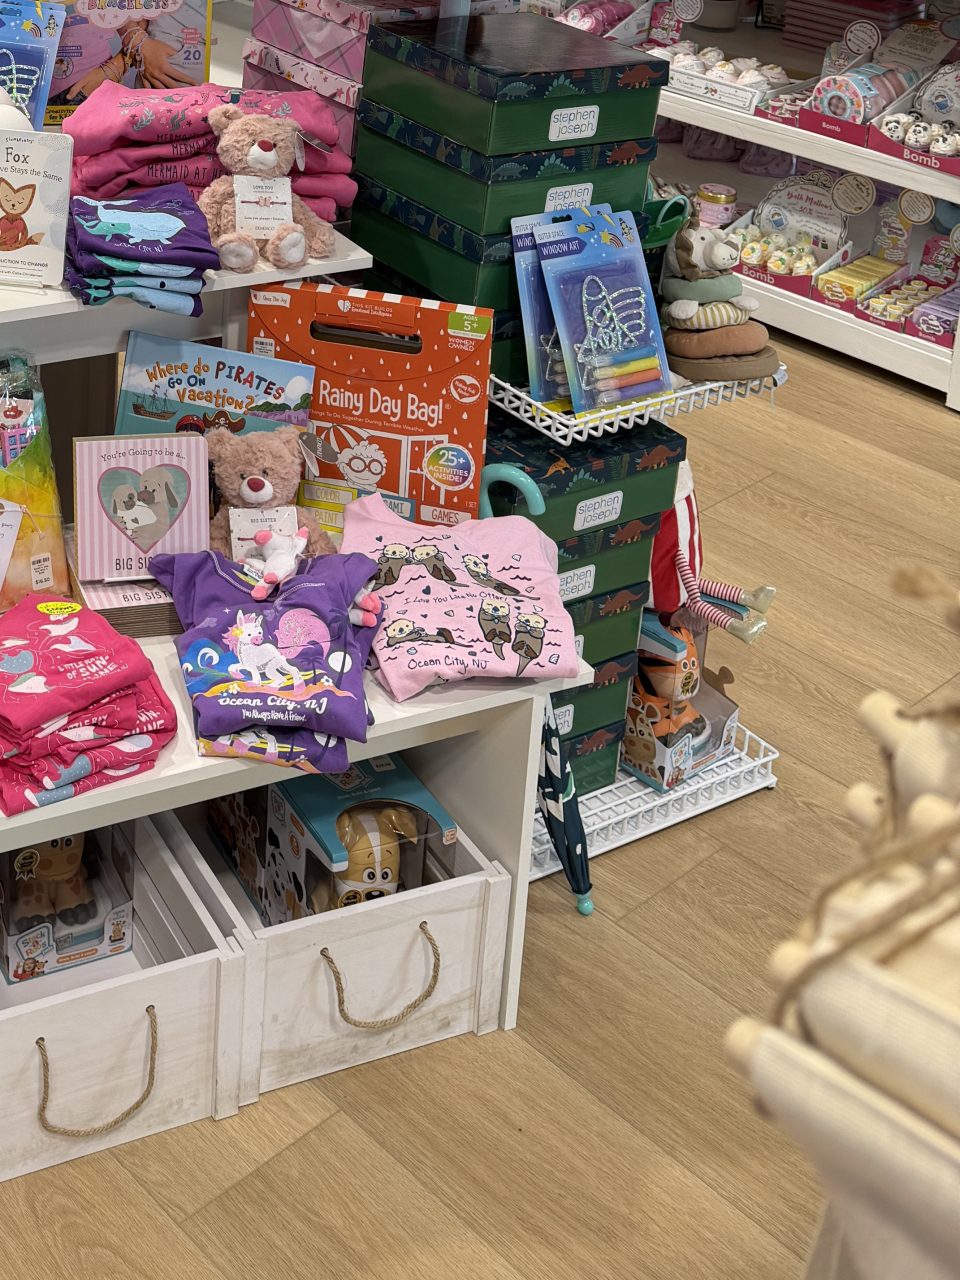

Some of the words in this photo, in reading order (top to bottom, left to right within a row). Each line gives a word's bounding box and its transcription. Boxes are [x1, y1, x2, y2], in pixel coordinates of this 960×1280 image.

[183, 49, 202, 61] 20
[552, 107, 596, 126] stephen
[556, 118, 596, 138] joseph
[822, 121, 841, 132] Bomb
[5, 146, 30, 164] Fox
[903, 148, 941, 169] Bomb
[10, 165, 29, 176] Stays
[29, 167, 41, 177] the
[42, 170, 63, 183] Same
[147, 162, 190, 178] MERMAID
[193, 165, 209, 178] AT
[548, 185, 590, 204] stephen
[537, 229, 552, 240] OUTER
[552, 229, 565, 238] SPACE
[564, 239, 581, 253] ART
[742, 265, 775, 285] Bomb
[464, 320, 479, 331] 5+
[448, 337, 475, 347] WOMEN
[918, 331, 937, 342] Bomb
[448, 342, 475, 352] OWNED
[145, 361, 189, 383] Where
[193, 356, 210, 376] do
[214, 360, 286, 401] PIRATES
[319, 379, 364, 416] Rainy
[369, 387, 404, 423] Day
[406, 398, 444, 428] Bag!
[100, 449, 127, 462] You're
[128, 447, 153, 458] Going
[154, 447, 163, 457] to
[164, 447, 175, 457] be
[438, 450, 466, 466] 25+
[428, 464, 469, 478] ACTIVITIES
[432, 471, 463, 483] INSIDE!
[315, 484, 342, 502] COLOR
[577, 494, 621, 517] stephen
[313, 508, 340, 526] PAINT
[431, 507, 460, 524] GAMES
[580, 505, 619, 527] joseph
[407, 657, 441, 670] Ocean
[444, 655, 469, 675] City,
[472, 658, 490, 670] NJ
[66, 670, 78, 680] OF
